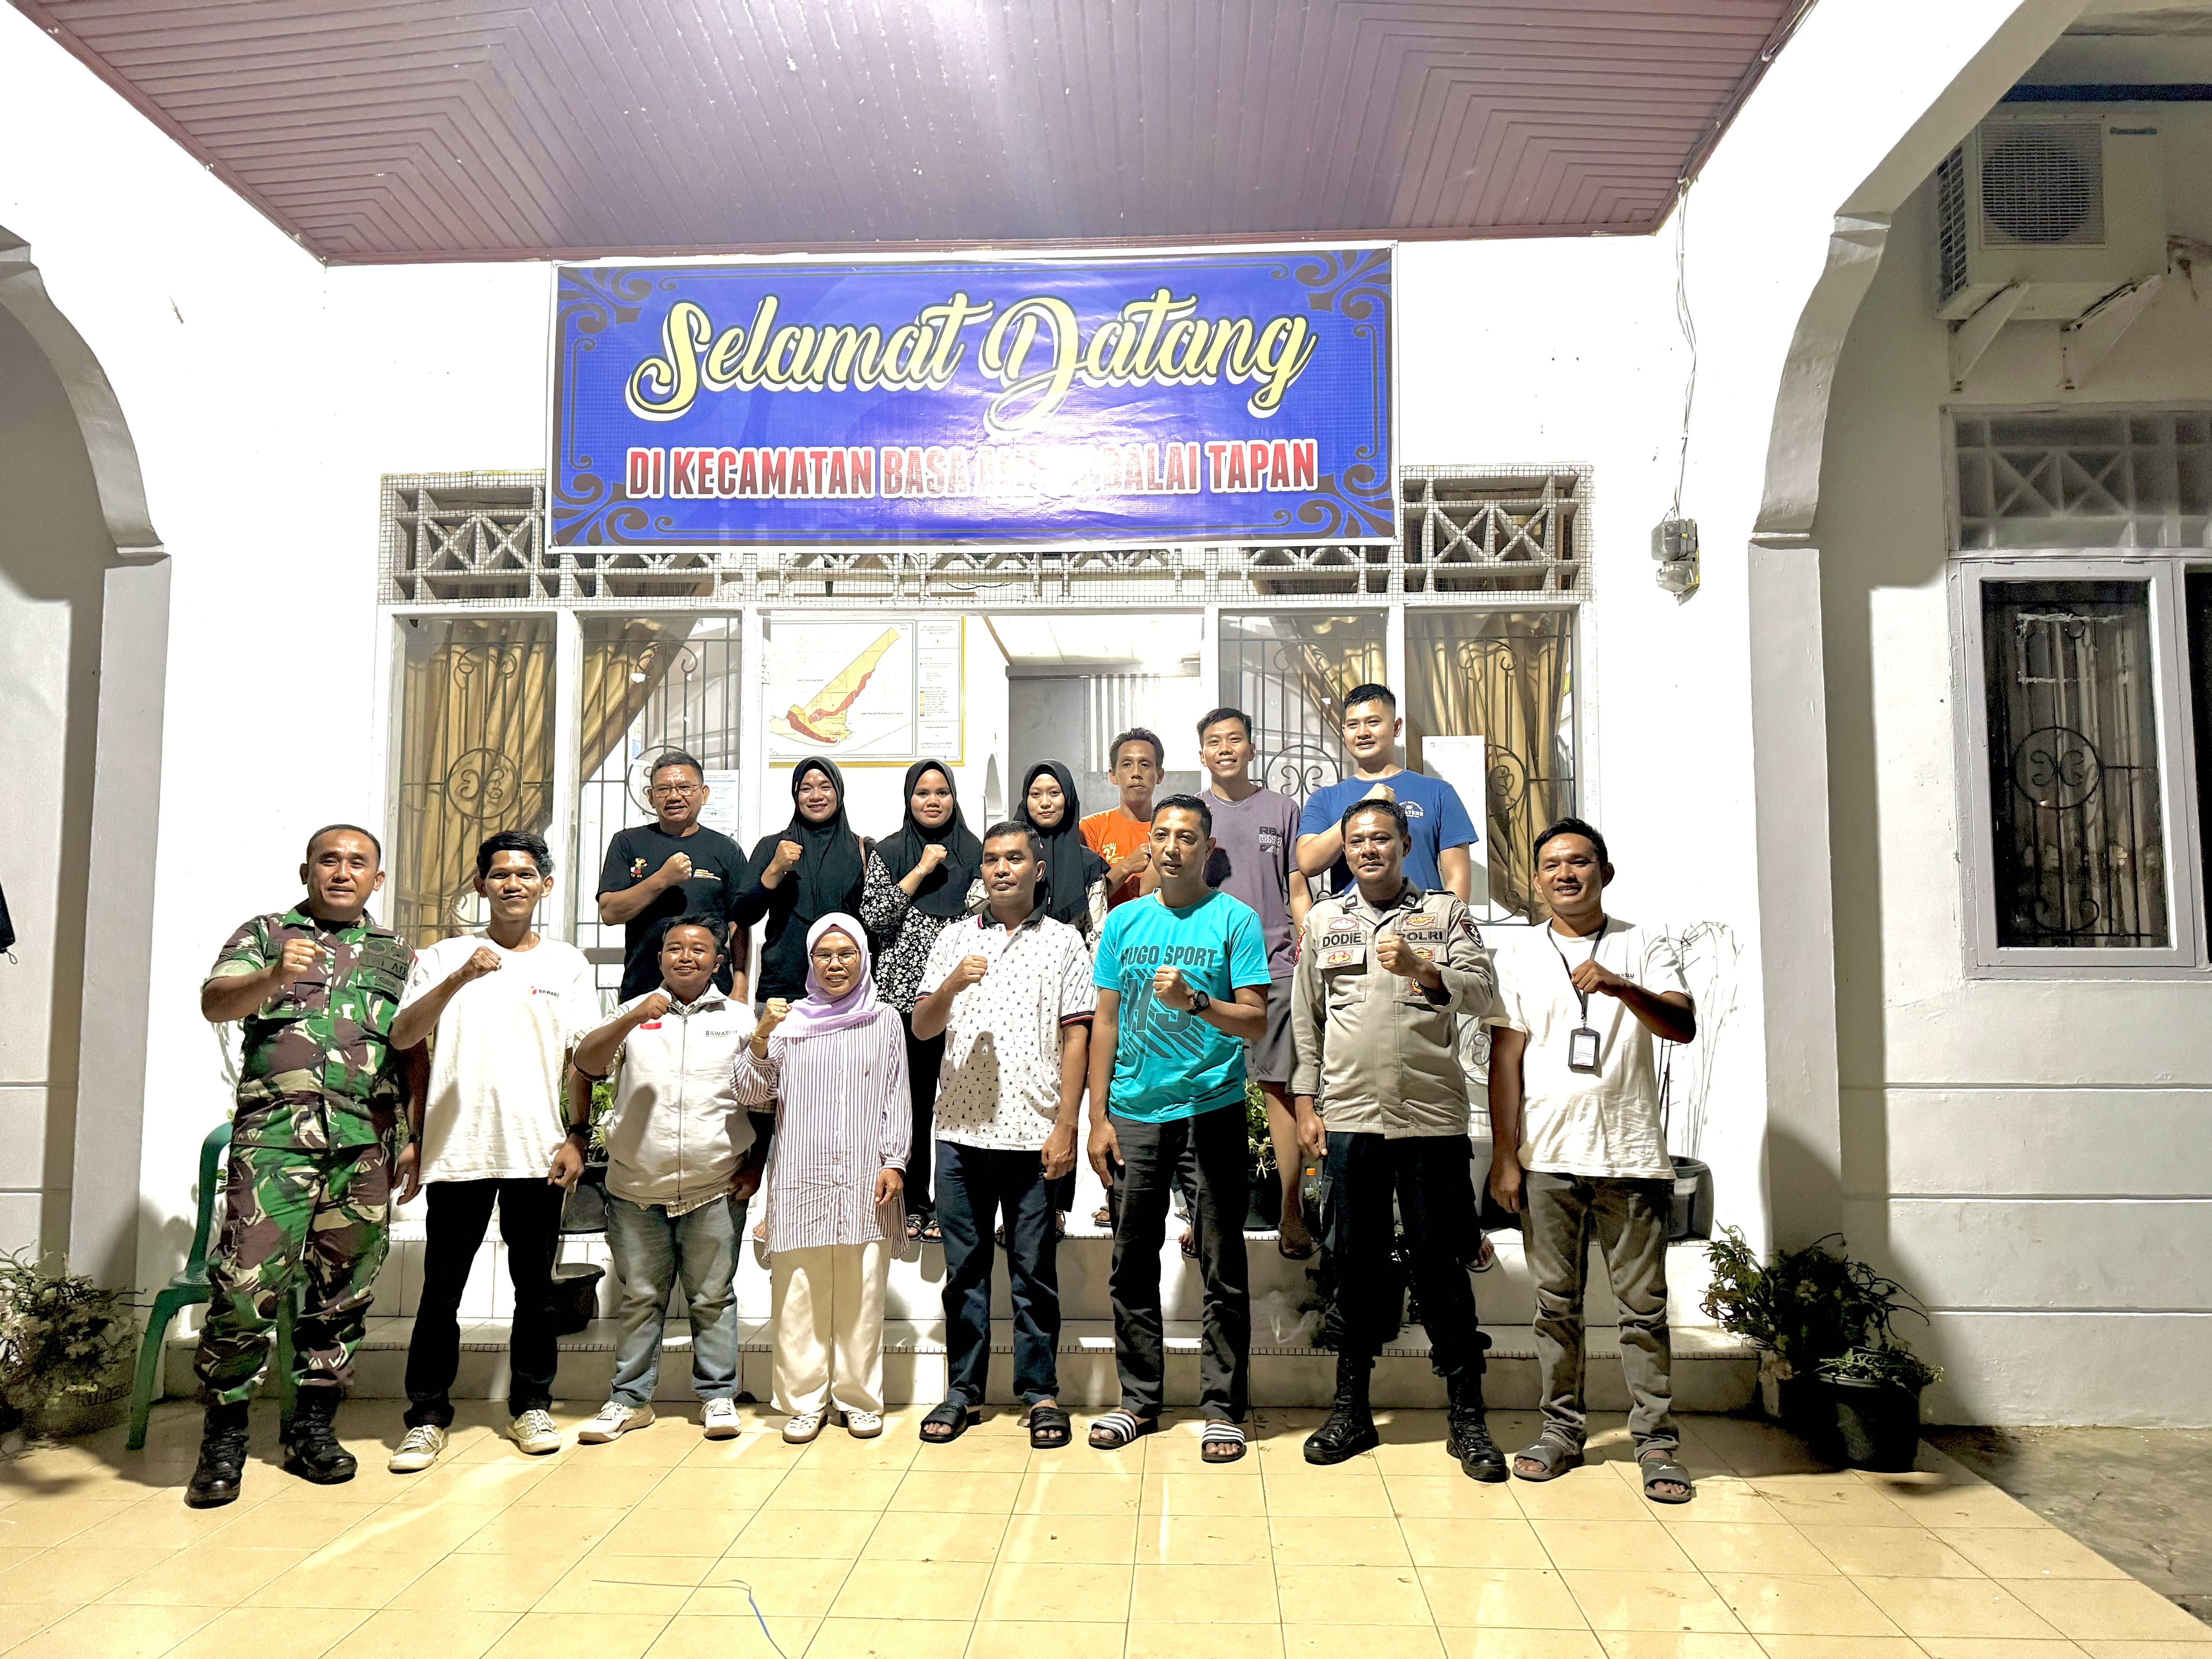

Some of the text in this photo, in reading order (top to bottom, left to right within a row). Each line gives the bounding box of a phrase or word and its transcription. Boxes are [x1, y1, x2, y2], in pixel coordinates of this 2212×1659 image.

[626, 287, 1318, 433] Selamat Datang
[628, 449, 662, 496] DI
[672, 448, 872, 496] KECAMATAN
[883, 448, 968, 496] BASA
[1102, 443, 1198, 492] BALAI
[1207, 441, 1316, 489] TAPAN
[1103, 847, 1118, 862] 27
[1322, 932, 1362, 947] DODIE
[1120, 945, 1218, 968] HUGO SPORT
